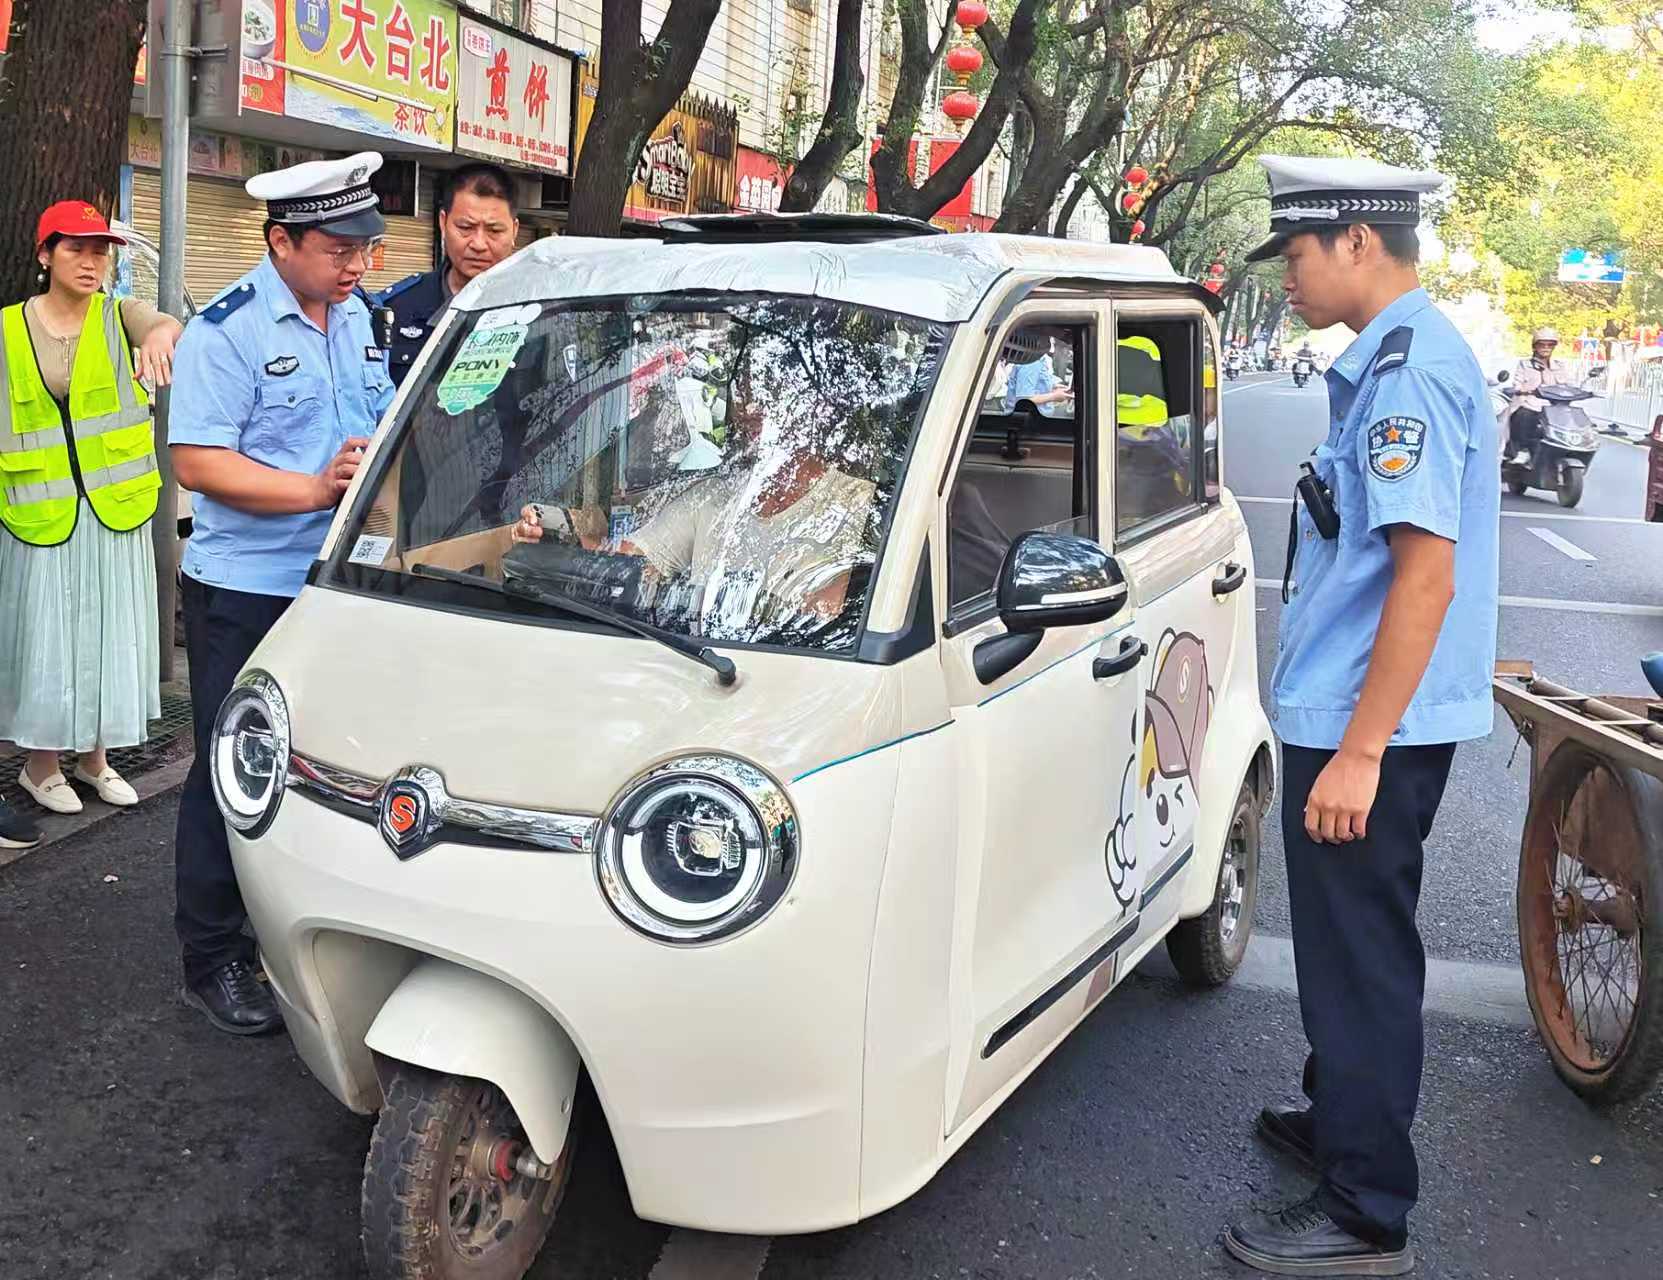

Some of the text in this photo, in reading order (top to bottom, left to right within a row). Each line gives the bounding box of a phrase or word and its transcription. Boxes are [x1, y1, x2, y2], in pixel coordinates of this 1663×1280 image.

[340, 0, 450, 89] 大台北
[394, 101, 427, 136] 茶饮
[485, 48, 550, 132] 煎饼
